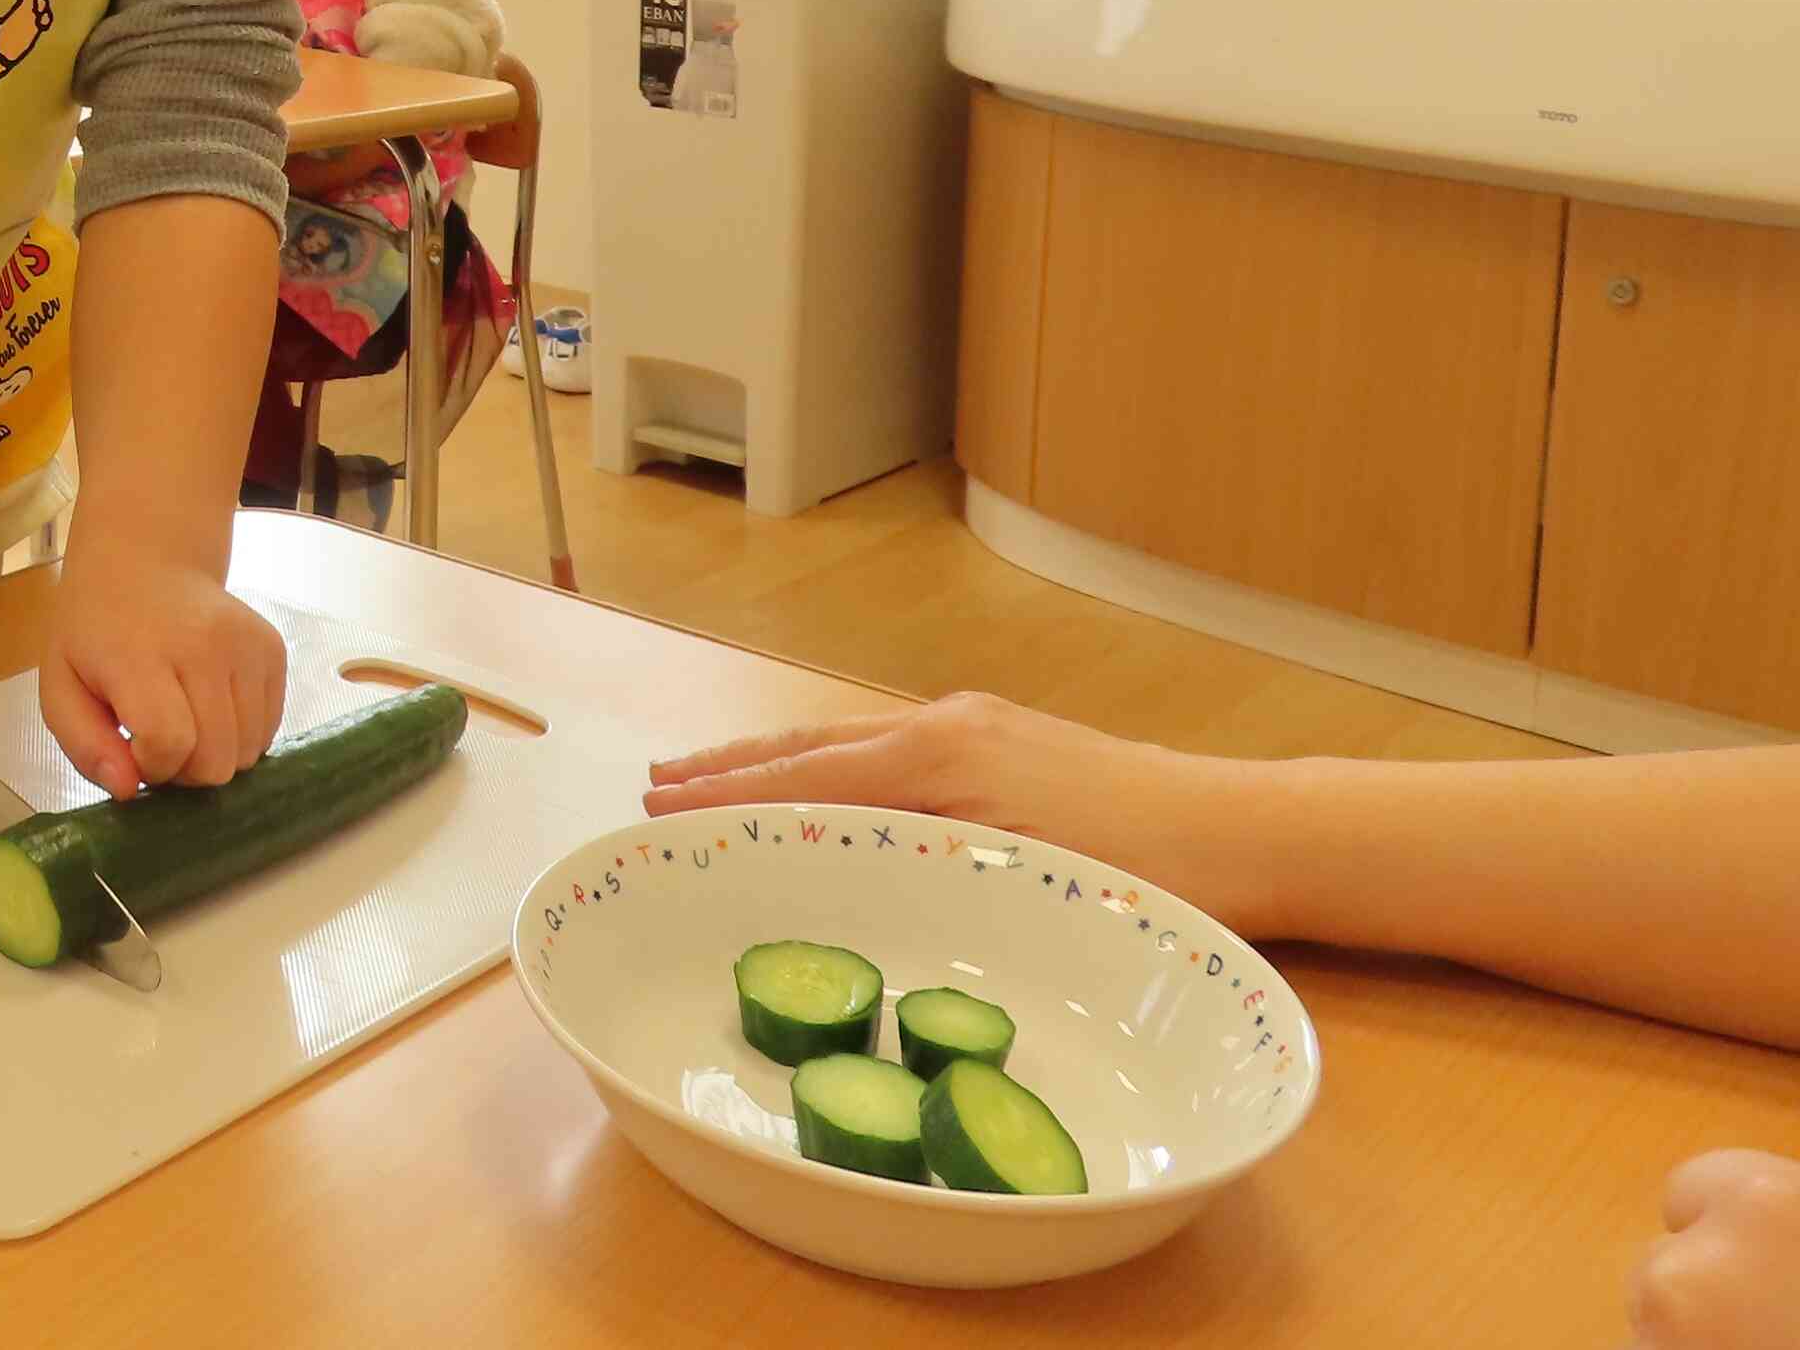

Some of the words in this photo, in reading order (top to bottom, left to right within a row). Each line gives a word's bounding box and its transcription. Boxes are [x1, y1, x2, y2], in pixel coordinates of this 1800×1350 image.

[642, 5, 686, 23] EBAN
[4, 296, 61, 350] Forever
[544, 907, 563, 932] Q
[572, 882, 587, 906] R
[604, 870, 621, 895] S
[635, 843, 651, 866] T
[691, 847, 710, 870] U
[741, 818, 759, 843] V
[800, 820, 826, 844] W
[870, 825, 896, 849] X
[945, 834, 964, 857] Y
[1001, 844, 1025, 869] Z
[1064, 878, 1082, 902] A
[1206, 952, 1224, 977] D
